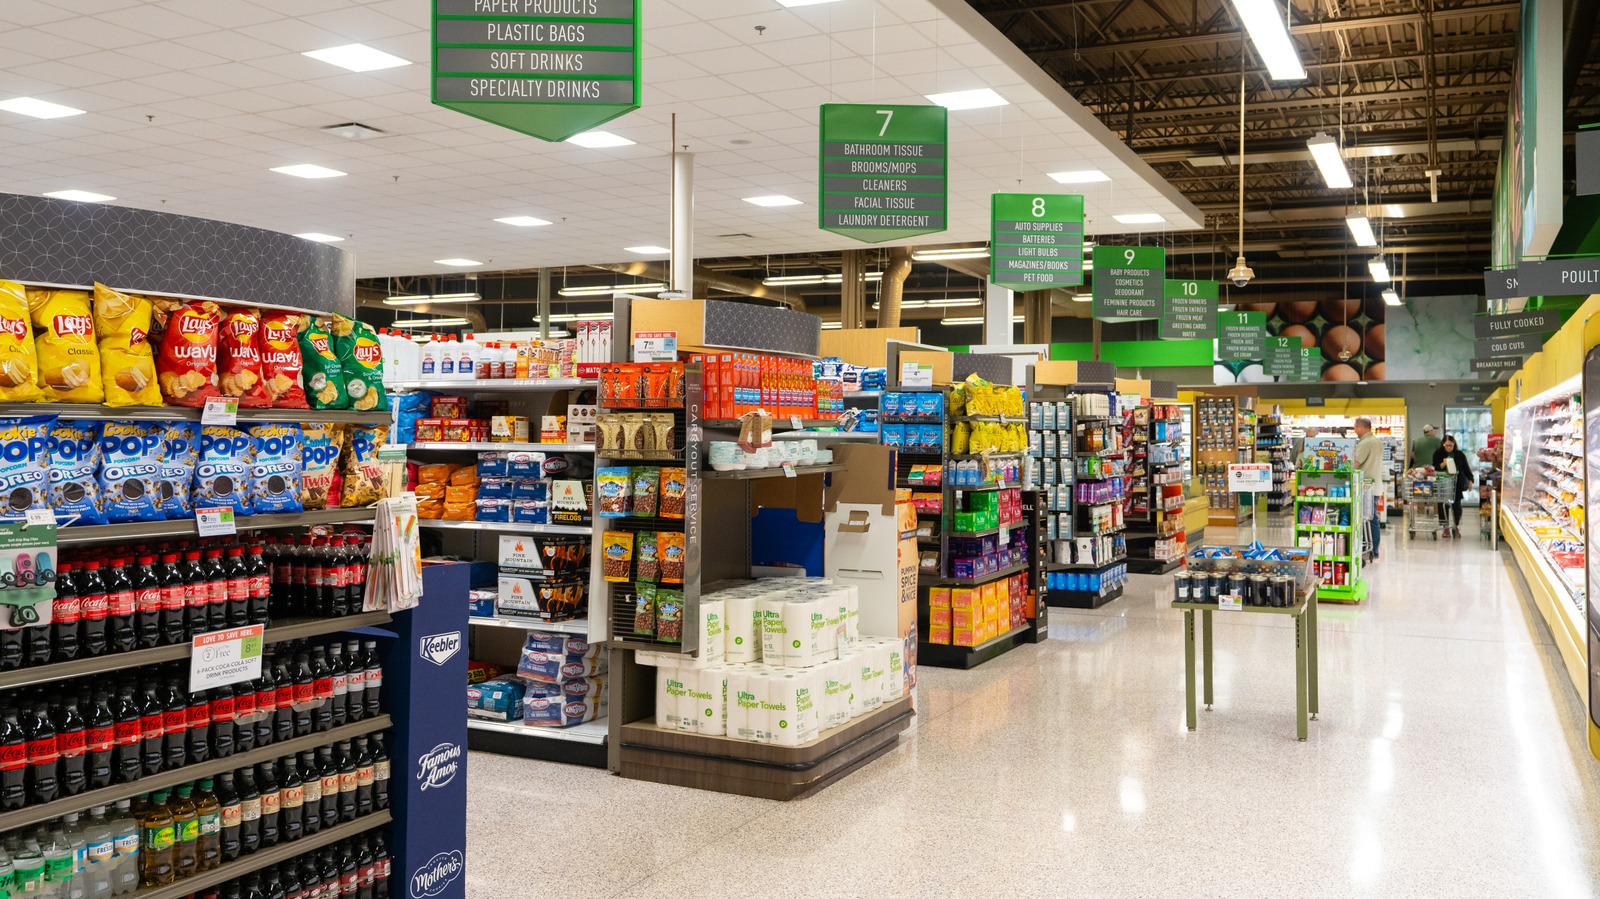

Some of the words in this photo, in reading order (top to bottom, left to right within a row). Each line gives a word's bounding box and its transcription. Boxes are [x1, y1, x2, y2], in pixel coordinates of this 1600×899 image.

[474, 0, 518, 13] PAPER
[524, 0, 596, 15] PRODUCTS
[487, 24, 543, 41] PLASTIC
[550, 25, 585, 42] BAGS
[490, 52, 525, 70] SOFT
[530, 54, 583, 71] DRINKS
[471, 79, 542, 97] SPECIALTY
[548, 81, 600, 98] DRINKS
[876, 110, 893, 136] 7
[844, 144, 890, 155] BATHROOM
[894, 145, 923, 156] TISSUE
[852, 161, 916, 173] BROOMS/MOPS
[863, 179, 907, 191] CLEANERS
[854, 197, 882, 208] FACIAL
[886, 198, 915, 209] TISSUE
[1032, 198, 1045, 217] 8
[839, 214, 877, 226] LAUNDRY
[881, 215, 929, 226] DETERGENT
[1015, 222, 1031, 230] AUTO
[1033, 223, 1063, 231] SUPPLIES
[1023, 235, 1055, 244] BATTERIES
[1018, 248, 1036, 256] LIGHT
[1038, 248, 1058, 256] BULBS
[1124, 250, 1135, 265] 9
[1009, 260, 1068, 270] MAGAZINES/BOOKS
[1037, 274, 1053, 282] FOOD
[1562, 270, 1599, 283] POULT
[1182, 283, 1197, 295] 10
[57, 315, 91, 335] Lay's
[1238, 313, 1248, 324] 11
[1490, 320, 1511, 330] FULLY
[1514, 317, 1544, 328] COOKED
[182, 316, 214, 335] Lay's
[234, 321, 258, 336] Lay's
[1278, 338, 1288, 347] 12
[1491, 343, 1507, 351] COLD
[1509, 342, 1524, 350] CUTS
[175, 344, 216, 362] wavy
[262, 351, 299, 366] wavy
[356, 344, 379, 362] Lay's
[104, 423, 147, 436] Cookie
[202, 425, 241, 438] Cookie
[250, 424, 287, 438] Cookie
[303, 433, 331, 447] Candy
[45, 436, 94, 464] POP
[101, 436, 160, 464] POP
[199, 435, 249, 461] POP
[302, 446, 339, 471] POP
[50, 467, 91, 481] OREO
[106, 465, 156, 479] OREO
[199, 464, 243, 477] OREO
[254, 463, 294, 476] OREO
[0, 471, 42, 490] OREO
[303, 474, 330, 489] Twix
[690, 485, 698, 543] SERVICE
[901, 565, 916, 575] PUMPKIN
[901, 574, 916, 588] SPICE
[901, 589, 906, 603] &
[906, 590, 916, 600] NICE
[763, 610, 779, 618] Ultra
[811, 612, 822, 621] Ultra
[763, 618, 784, 626] Paper
[764, 625, 787, 634] Towels
[203, 636, 215, 644] LOVE
[226, 631, 238, 639] SAVE
[216, 650, 230, 658] Free
[422, 638, 458, 659] Keebler
[222, 666, 248, 675] PRODUCTS
[667, 679, 683, 688] Ultra
[666, 687, 686, 697] Paper
[688, 689, 712, 700] Towels
[738, 691, 755, 700] Ultra
[796, 687, 808, 697] Ultra
[738, 699, 758, 710] Paper
[760, 701, 786, 711] Towels
[796, 694, 810, 704] Paper
[797, 701, 813, 713] Towels
[417, 745, 460, 780] Famous
[421, 761, 456, 791] Amos
[415, 857, 460, 892] Mother's
